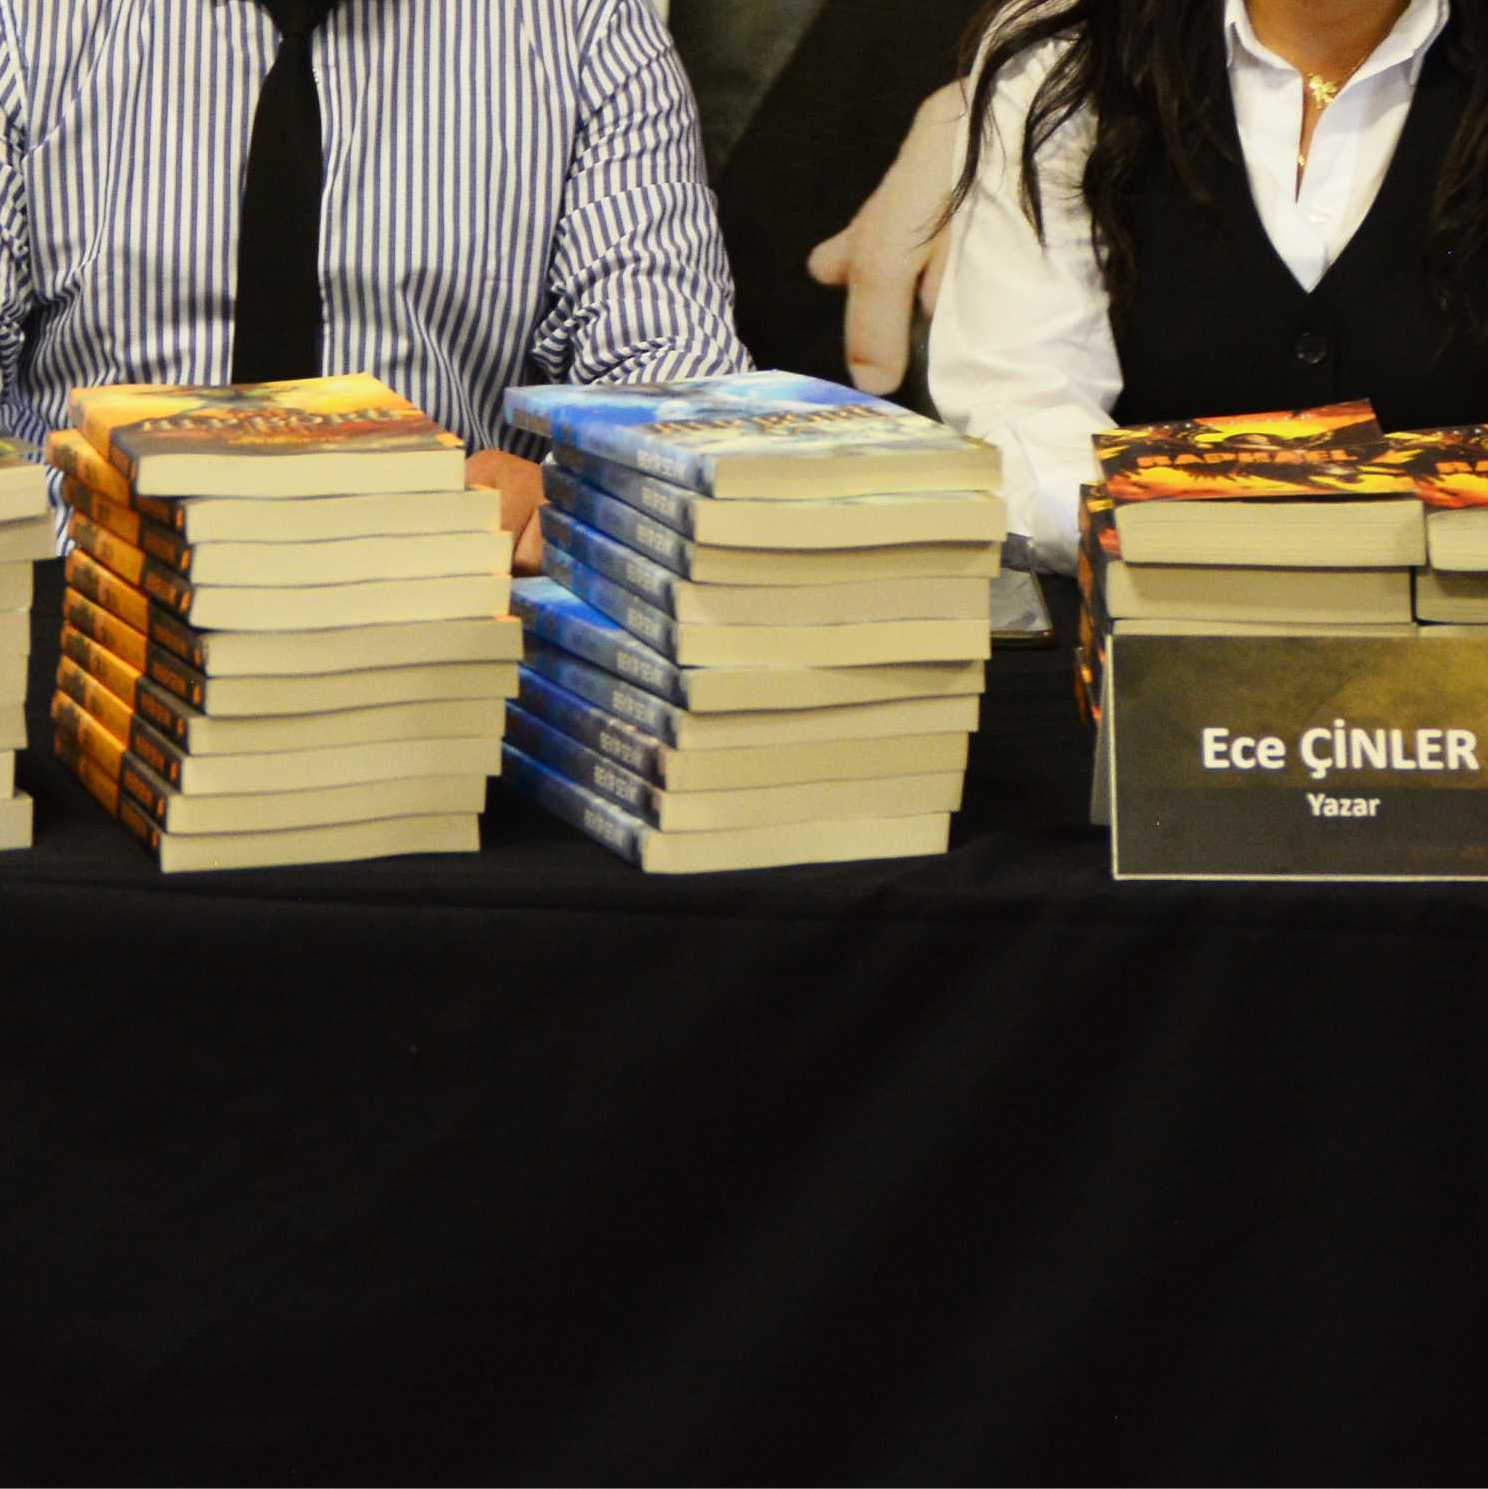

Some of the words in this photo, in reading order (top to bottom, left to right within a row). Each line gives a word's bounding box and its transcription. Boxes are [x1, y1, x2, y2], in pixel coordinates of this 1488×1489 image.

[1201, 726, 1285, 770] Ece
[1300, 717, 1480, 781] ÇİNLER
[1306, 792, 1381, 818] Yazar
